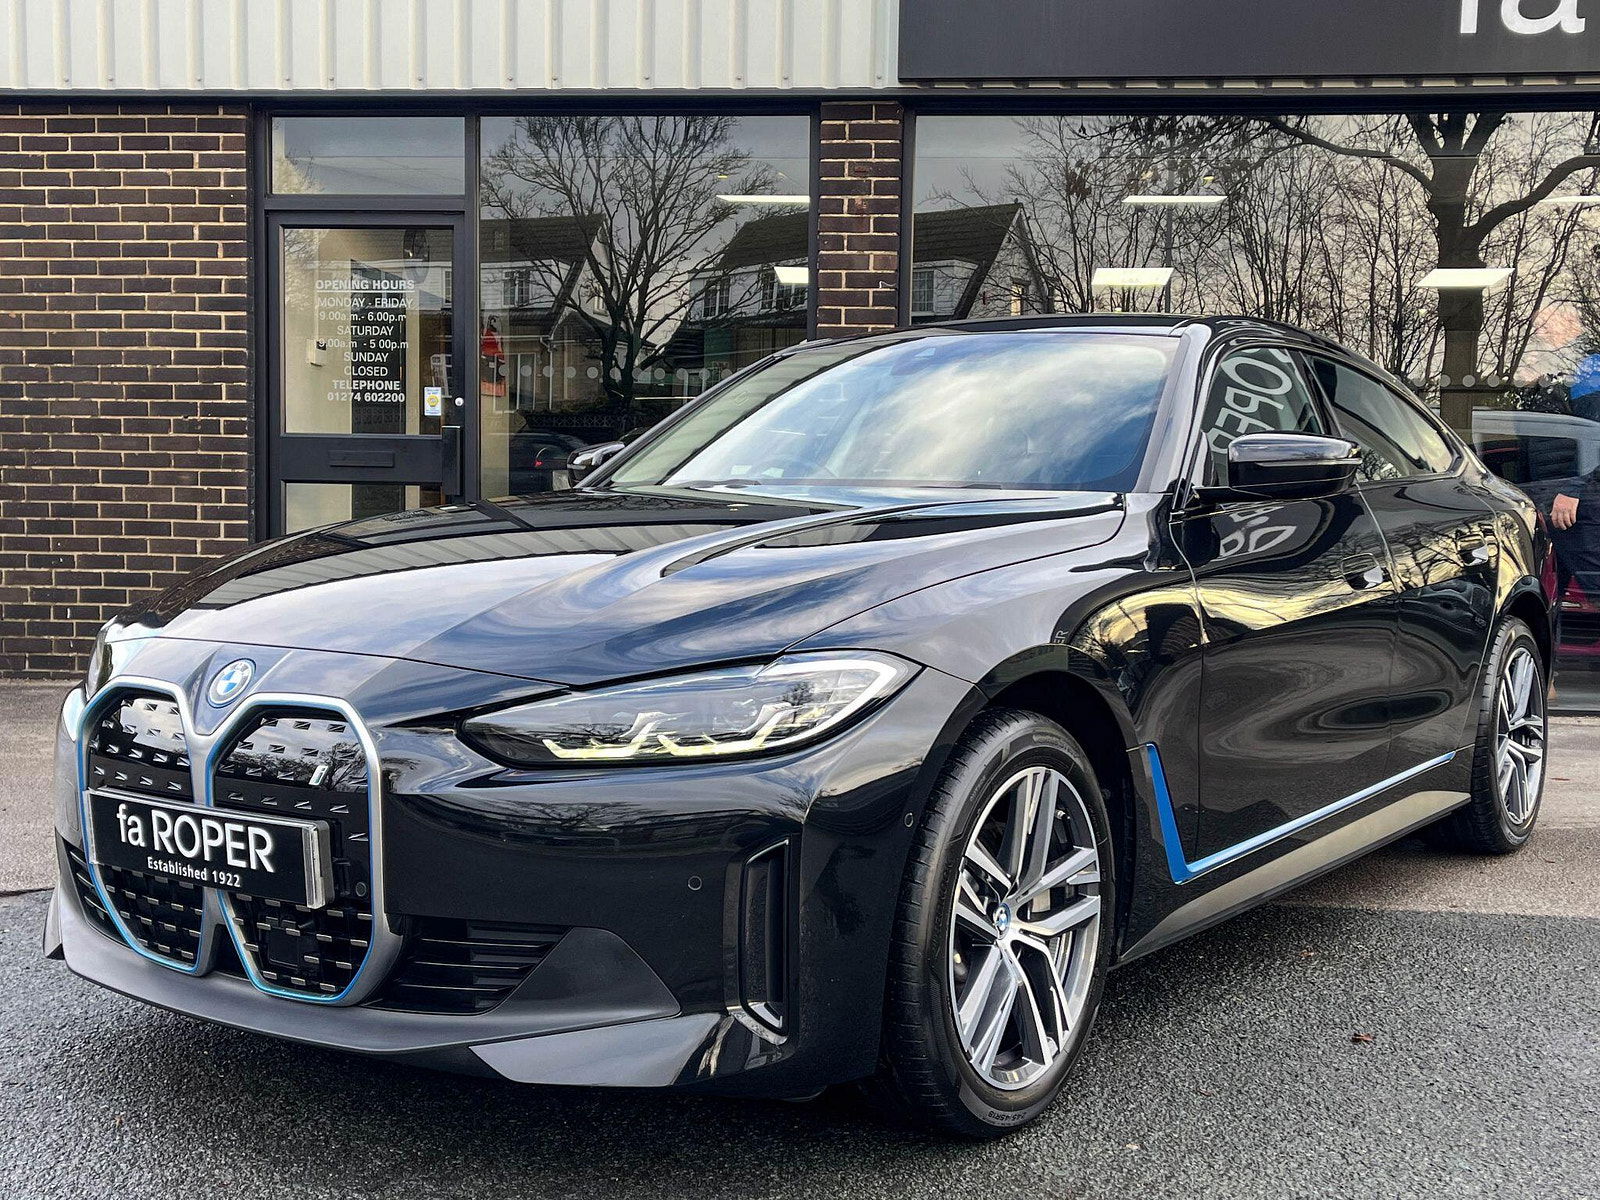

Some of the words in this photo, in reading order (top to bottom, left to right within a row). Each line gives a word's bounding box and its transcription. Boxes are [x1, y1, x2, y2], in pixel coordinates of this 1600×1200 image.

[315, 279, 369, 290] OPENING
[372, 279, 415, 290] HOURS
[317, 297, 366, 308] MONDAY
[375, 298, 414, 308] FRIDAY
[337, 325, 394, 336] SATURDAY
[343, 351, 389, 362] SUNDAY
[344, 366, 388, 377] CLOSED
[332, 380, 401, 391] TELEPHONE
[327, 392, 362, 402] 01274
[364, 392, 406, 402] 602200
[116, 803, 146, 848] fa
[151, 809, 275, 874] ROPER
[147, 856, 208, 882] Established
[211, 870, 241, 888] 1922
